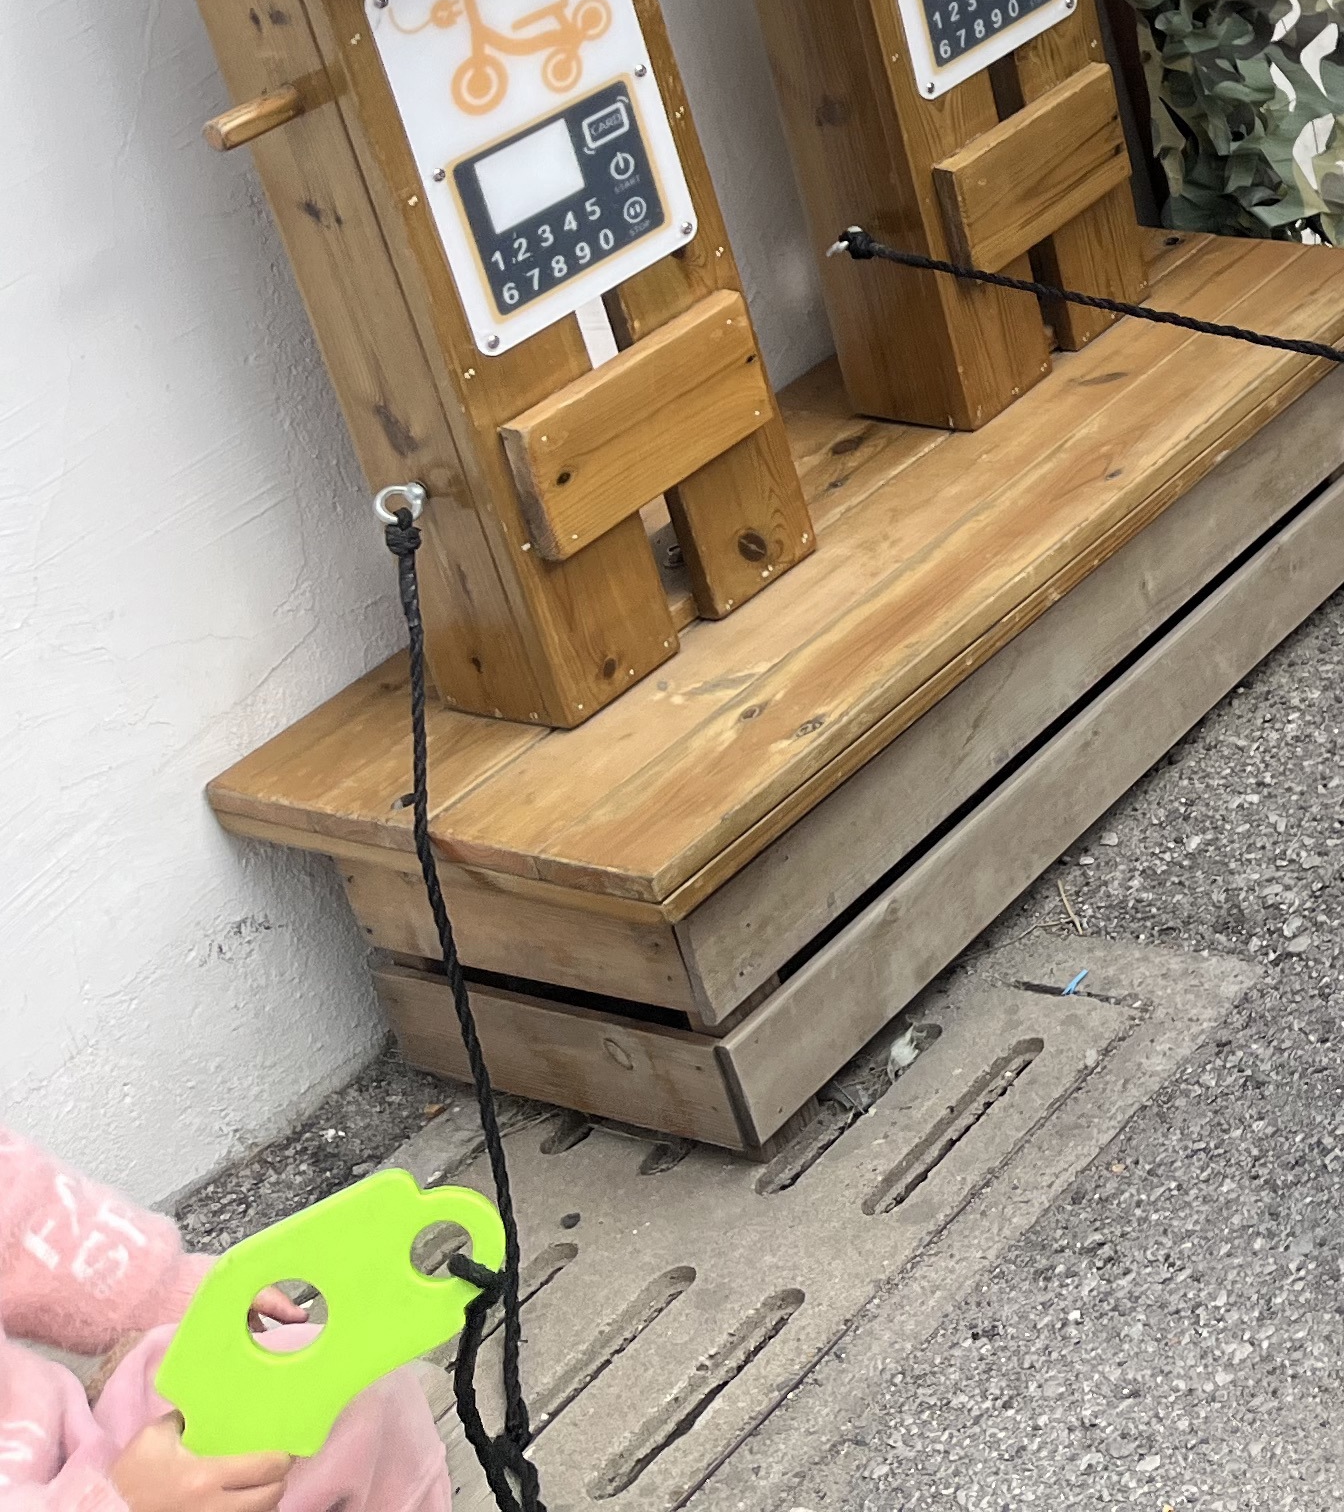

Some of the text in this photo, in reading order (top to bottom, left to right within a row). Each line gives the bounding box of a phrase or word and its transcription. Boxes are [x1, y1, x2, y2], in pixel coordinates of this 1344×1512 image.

[933, 11, 943, 29] 1
[948, 1, 960, 22] 2
[939, 0, 1019, 59] 6 7 8 9 0
[590, 113, 622, 136] CARD
[491, 197, 601, 271] 1 2 3 4 5
[502, 228, 615, 304] 6 7 8 9 0
